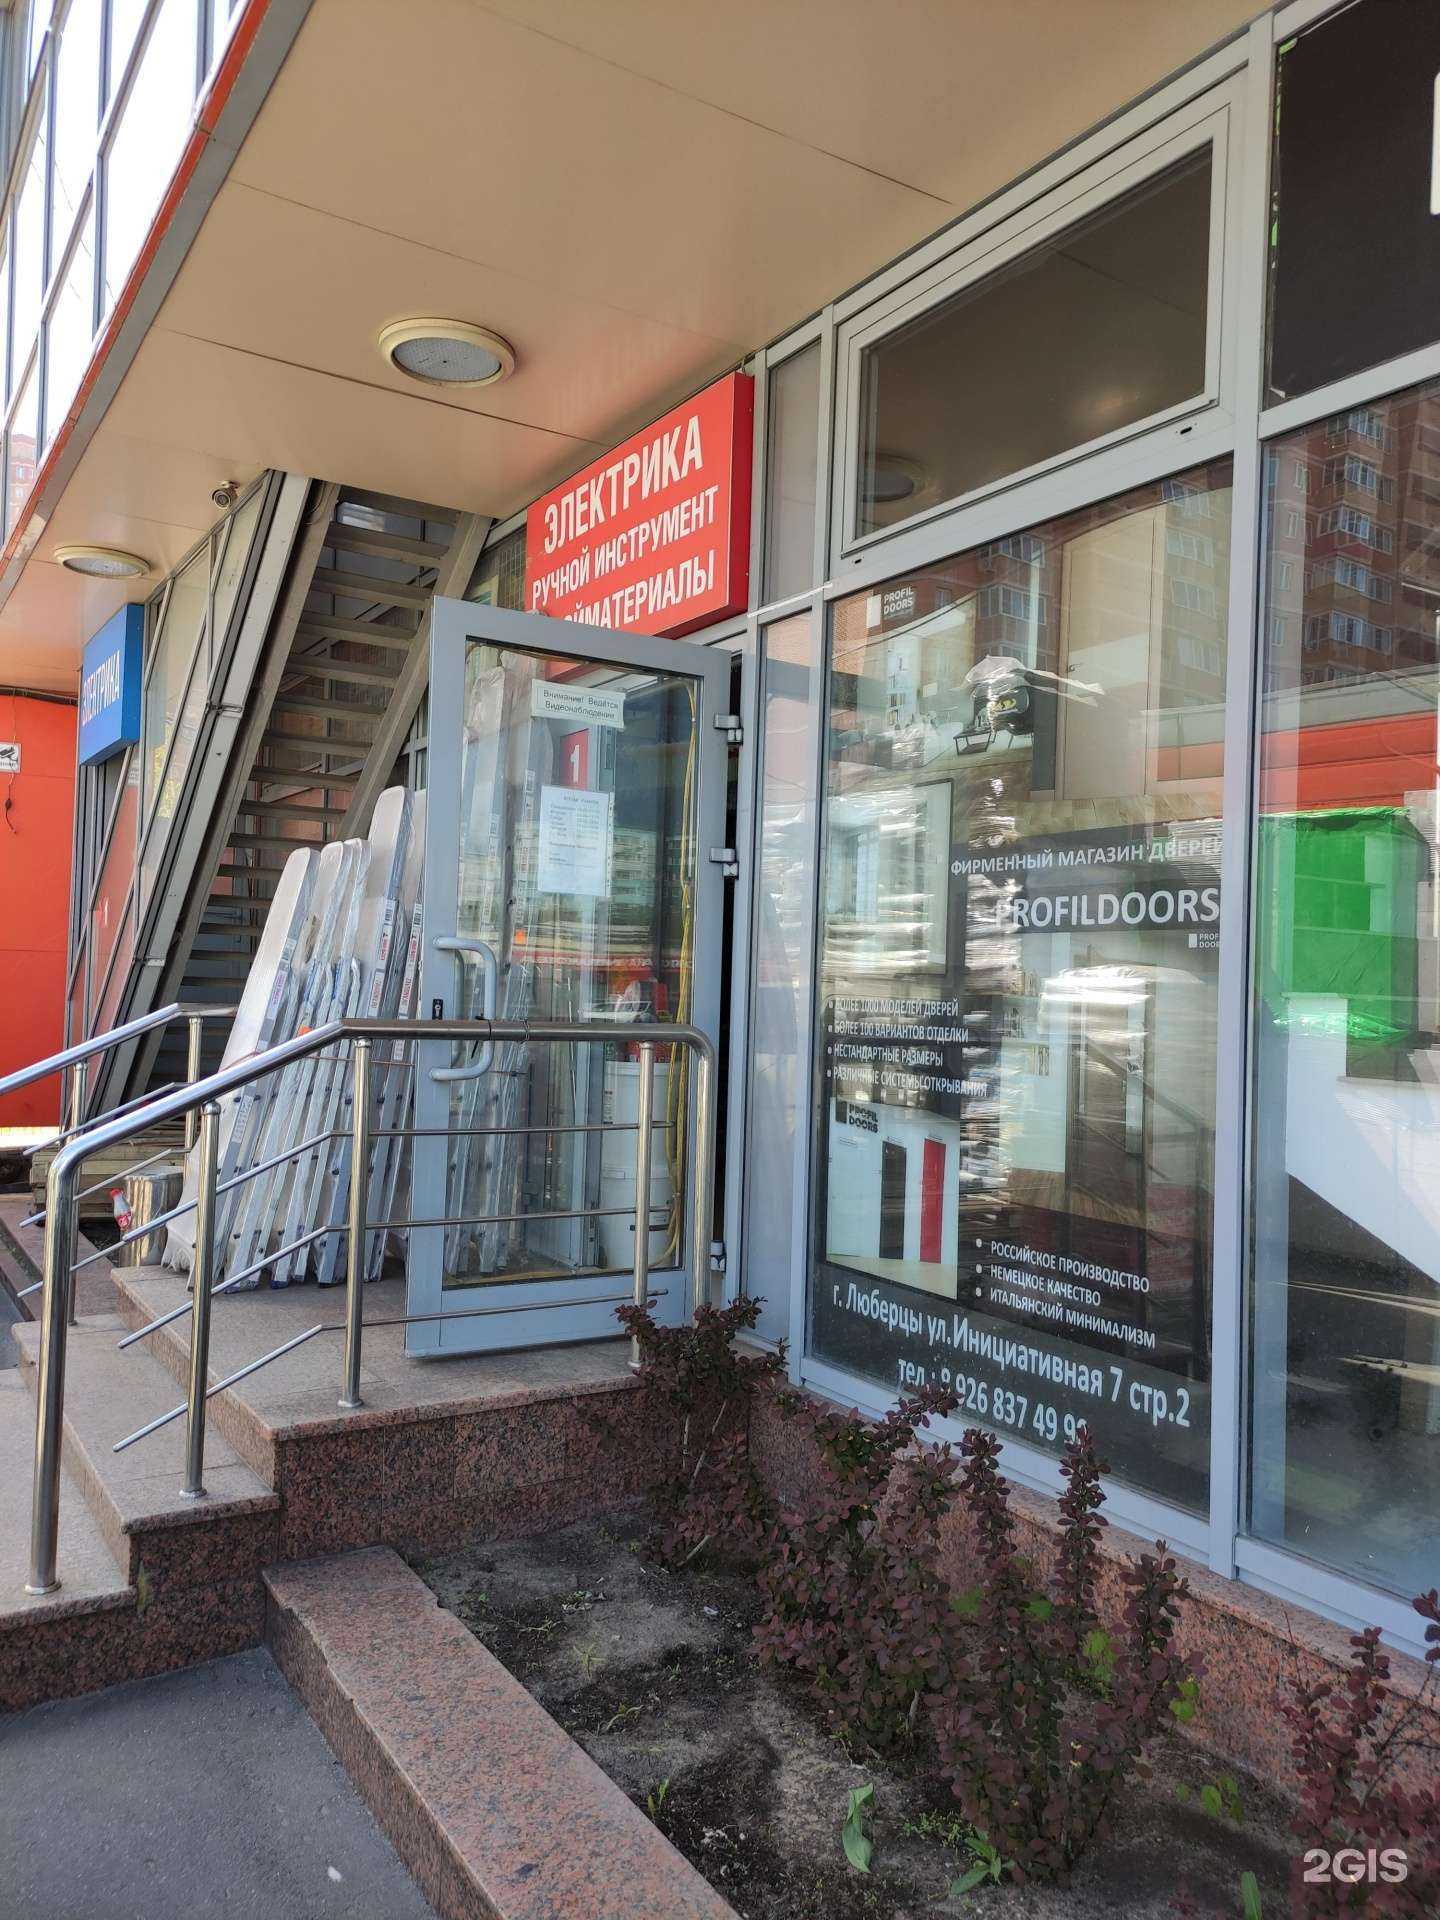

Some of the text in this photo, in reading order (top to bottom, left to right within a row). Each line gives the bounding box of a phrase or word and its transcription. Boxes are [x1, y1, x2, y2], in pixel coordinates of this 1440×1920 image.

[544, 415, 703, 554] ЭЛЕКТРИКА
[532, 485, 720, 610] РУЧНОЙ ИНСТРУМЕНТ
[564, 549, 715, 630] ЙМАТЕРИАЛЫ
[883, 597, 914, 616] DOORS
[884, 587, 914, 604] PROFIL
[570, 744, 580, 784] 1
[950, 849, 1053, 876] ФИРМЕННЫЙ
[1058, 843, 1143, 866] МАГАЗИН
[879, 997, 922, 1016] МОДЕЛЕЙ
[923, 997, 959, 1017] ДВЕРЕЙ
[834, 1020, 969, 1044] БОЛЕЕ 100 ВАРИАНТОВ ОТДЕЛКИ
[834, 1043, 943, 1067] НЕСТАНДАРТНЫЕ РАЗМЕРЫ
[833, 1067, 988, 1097] РАЗЛИЧНЫЕ СИСТЕМЫ ОТКРЫВАНИЯ
[990, 1264, 1101, 1306] НЕМЕЦКОЕ КАЧЕСТВО
[991, 1240, 1150, 1293] РОССИЙСКОЕ ПРОИЗВОДСТВО
[990, 1287, 1156, 1349] ИТАЛЬЯНСКИЙ МИНИМАЛИЗМ
[833, 1285, 842, 1307] г.
[845, 1282, 923, 1337] Люберцы
[1110, 1366, 1123, 1402] 7
[955, 1373, 988, 1414] 926
[992, 1388, 1028, 1428] 837
[1033, 1403, 1058, 1441] 49
